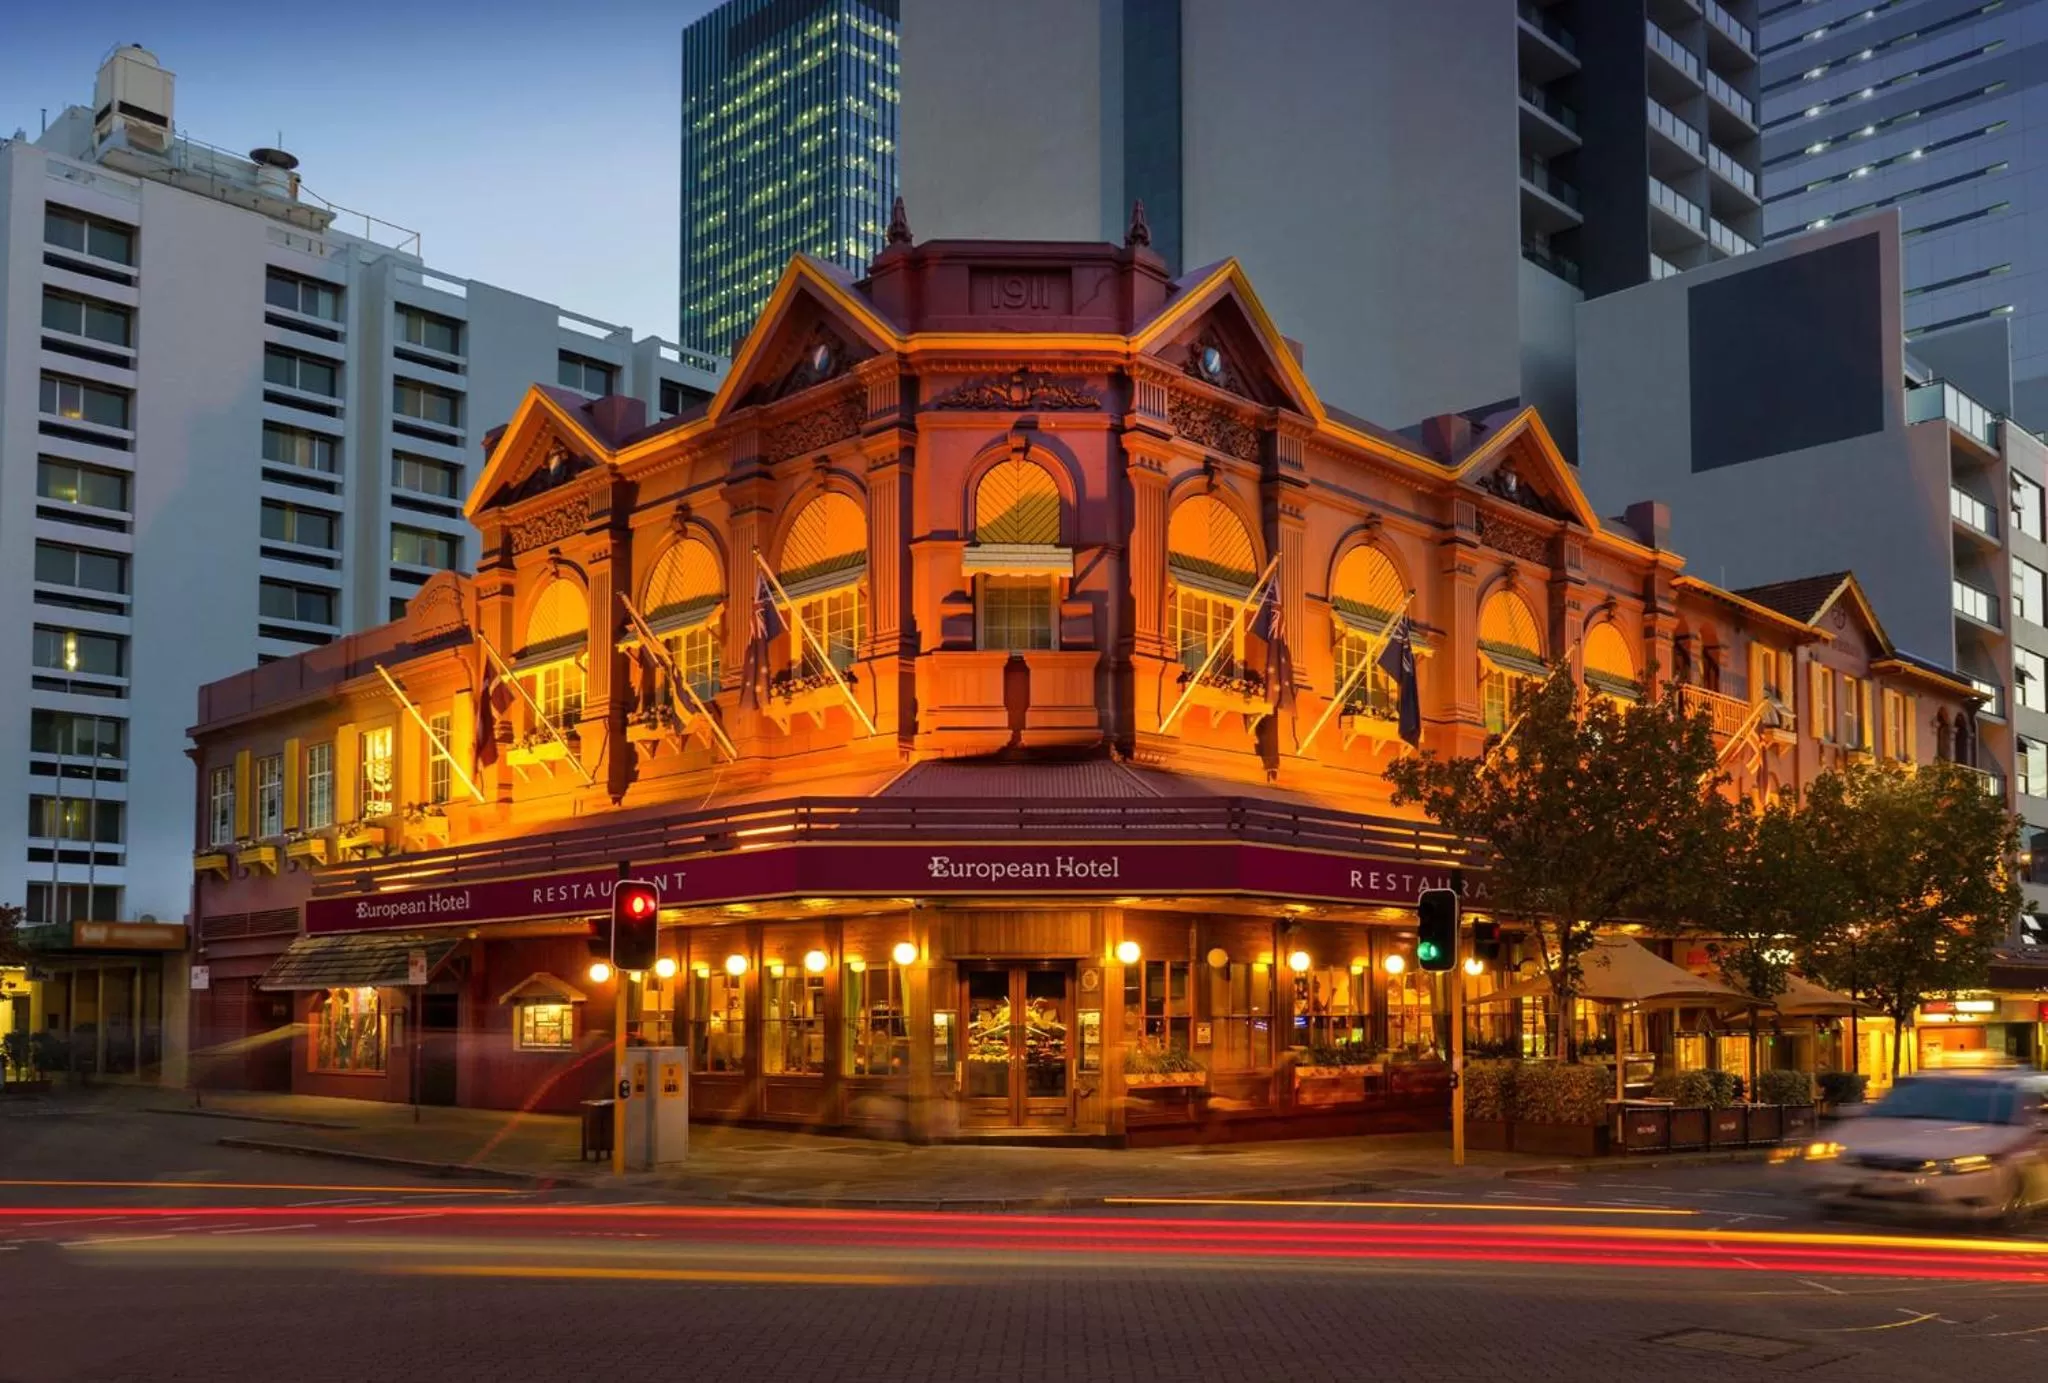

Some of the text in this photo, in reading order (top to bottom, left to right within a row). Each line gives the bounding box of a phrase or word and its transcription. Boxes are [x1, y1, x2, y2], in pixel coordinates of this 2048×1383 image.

[991, 276, 1049, 310] 1911
[928, 856, 1119, 882] European Hotel
[533, 872, 687, 904] RESTAUNT
[356, 890, 469, 919] European Hotel
